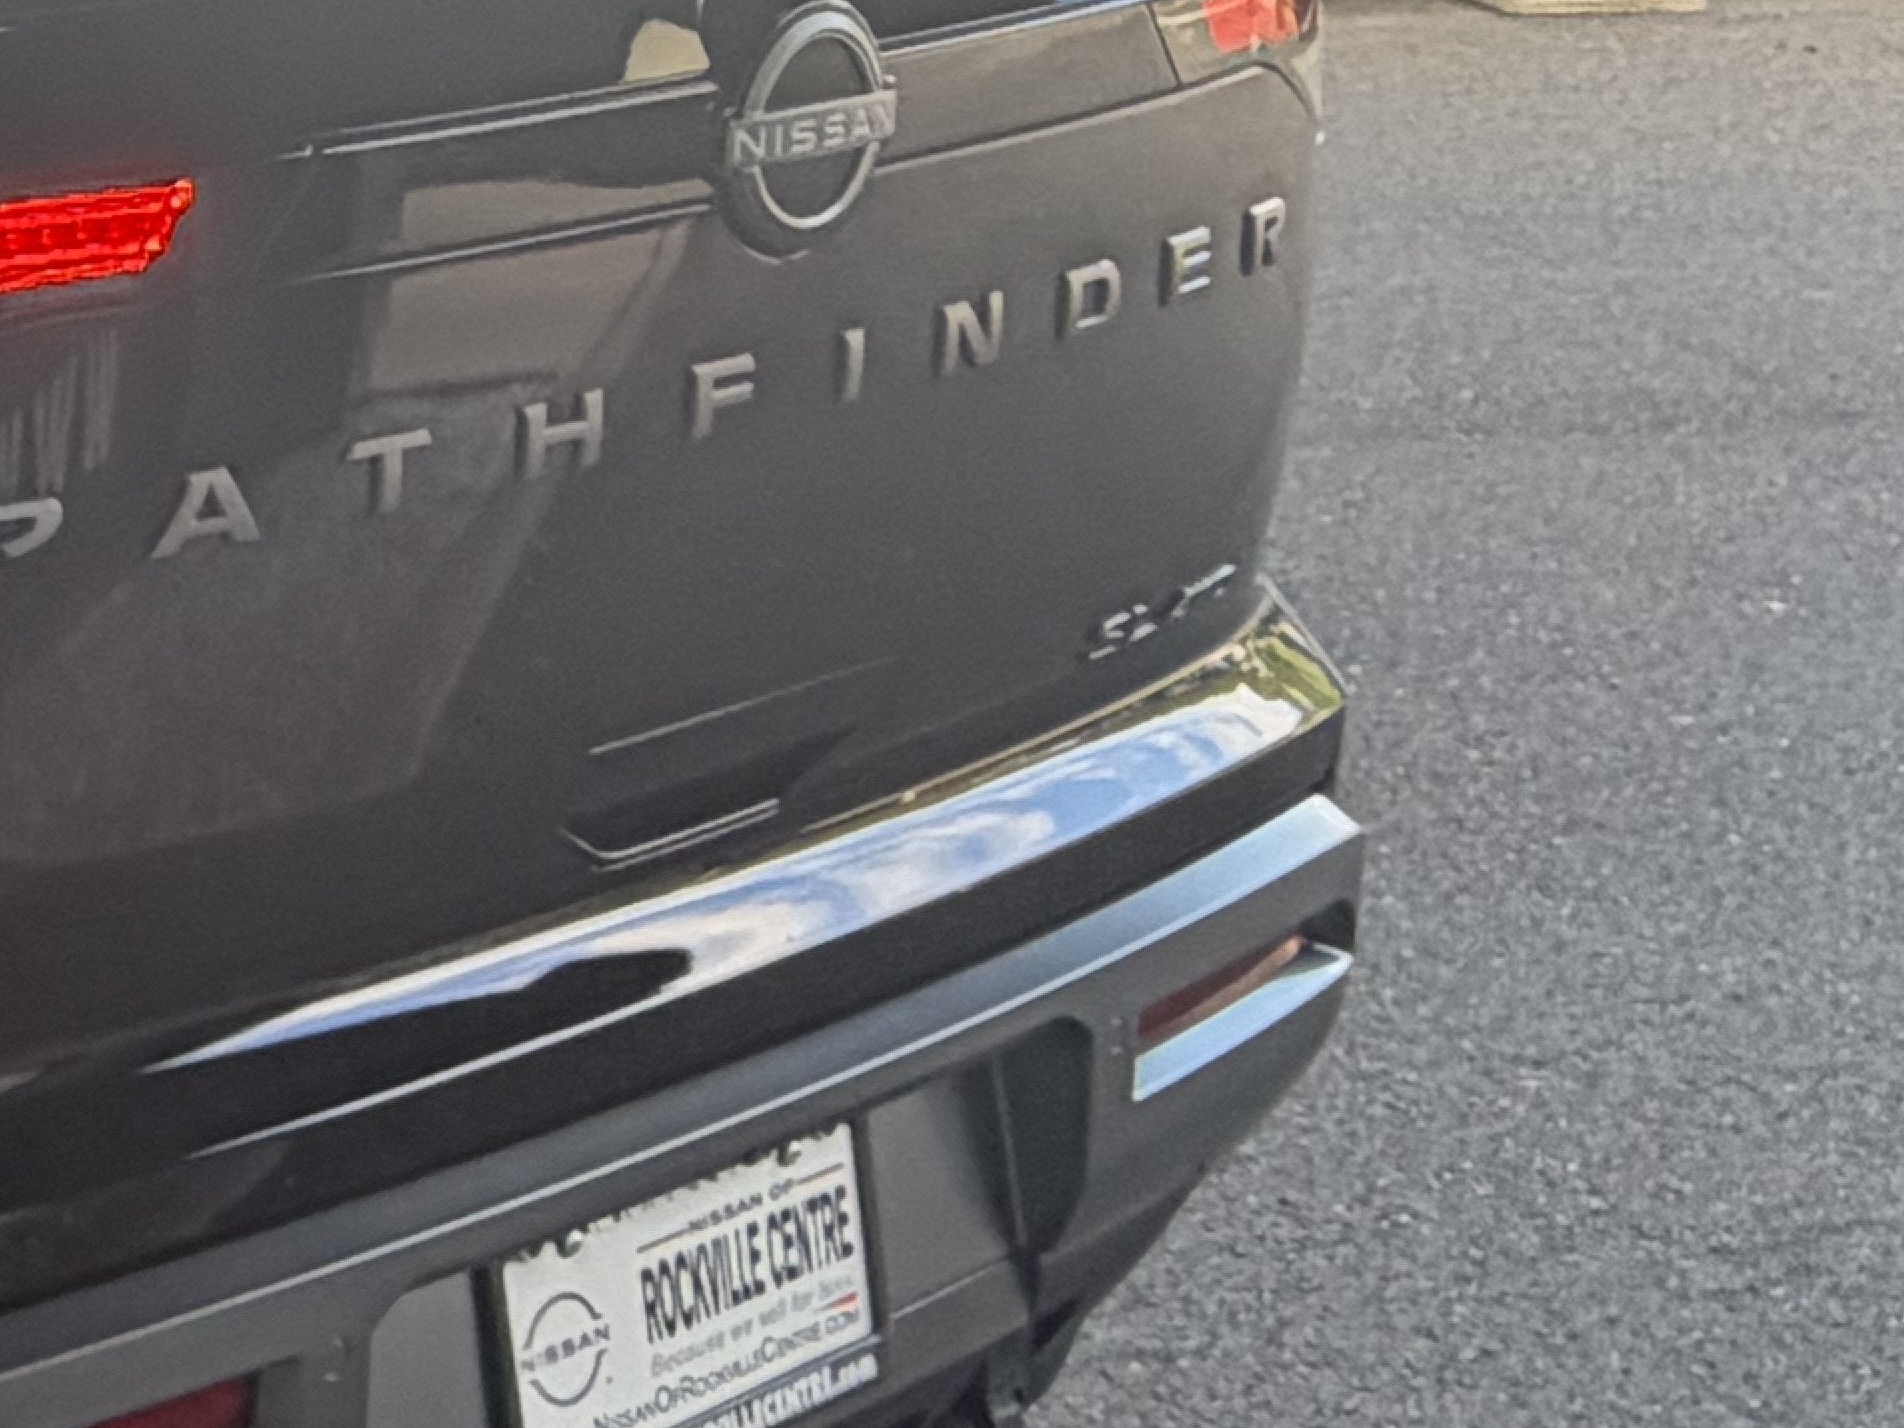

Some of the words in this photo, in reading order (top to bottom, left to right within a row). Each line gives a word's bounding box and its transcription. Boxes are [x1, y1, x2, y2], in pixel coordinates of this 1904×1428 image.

[732, 104, 895, 164] NISSAN
[688, 1191, 763, 1231] NISSAN
[639, 1220, 766, 1345] ROCKVILLE
[766, 1184, 854, 1290] CENTRE
[520, 1323, 610, 1373] NISSAN
